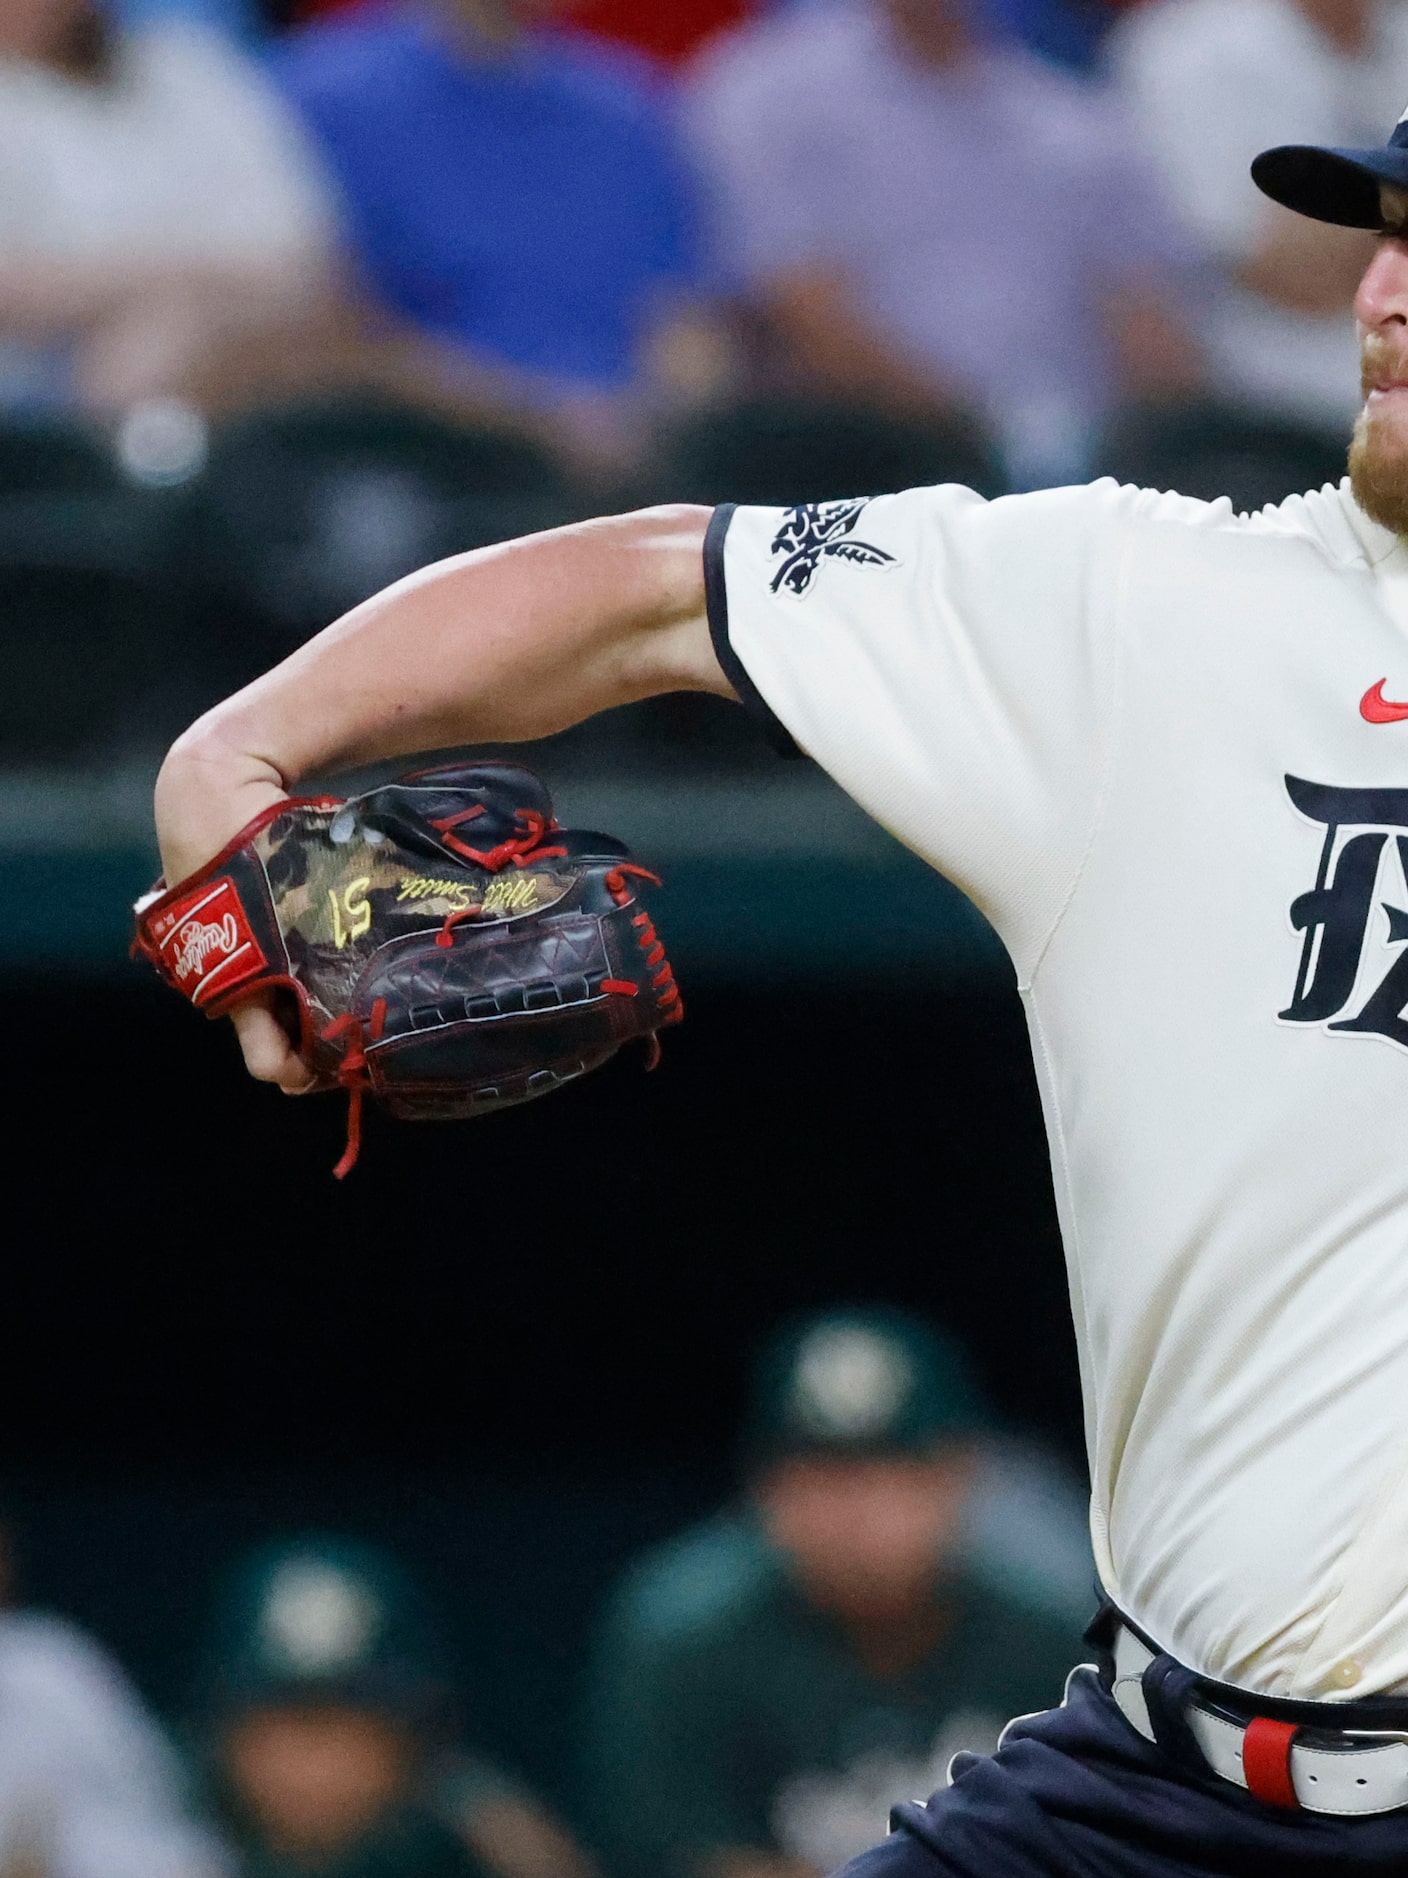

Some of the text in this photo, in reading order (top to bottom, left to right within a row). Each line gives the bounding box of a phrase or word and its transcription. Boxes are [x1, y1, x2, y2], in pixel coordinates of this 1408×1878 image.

[328, 876, 372, 950] 51
[397, 876, 538, 911] Will Smith
